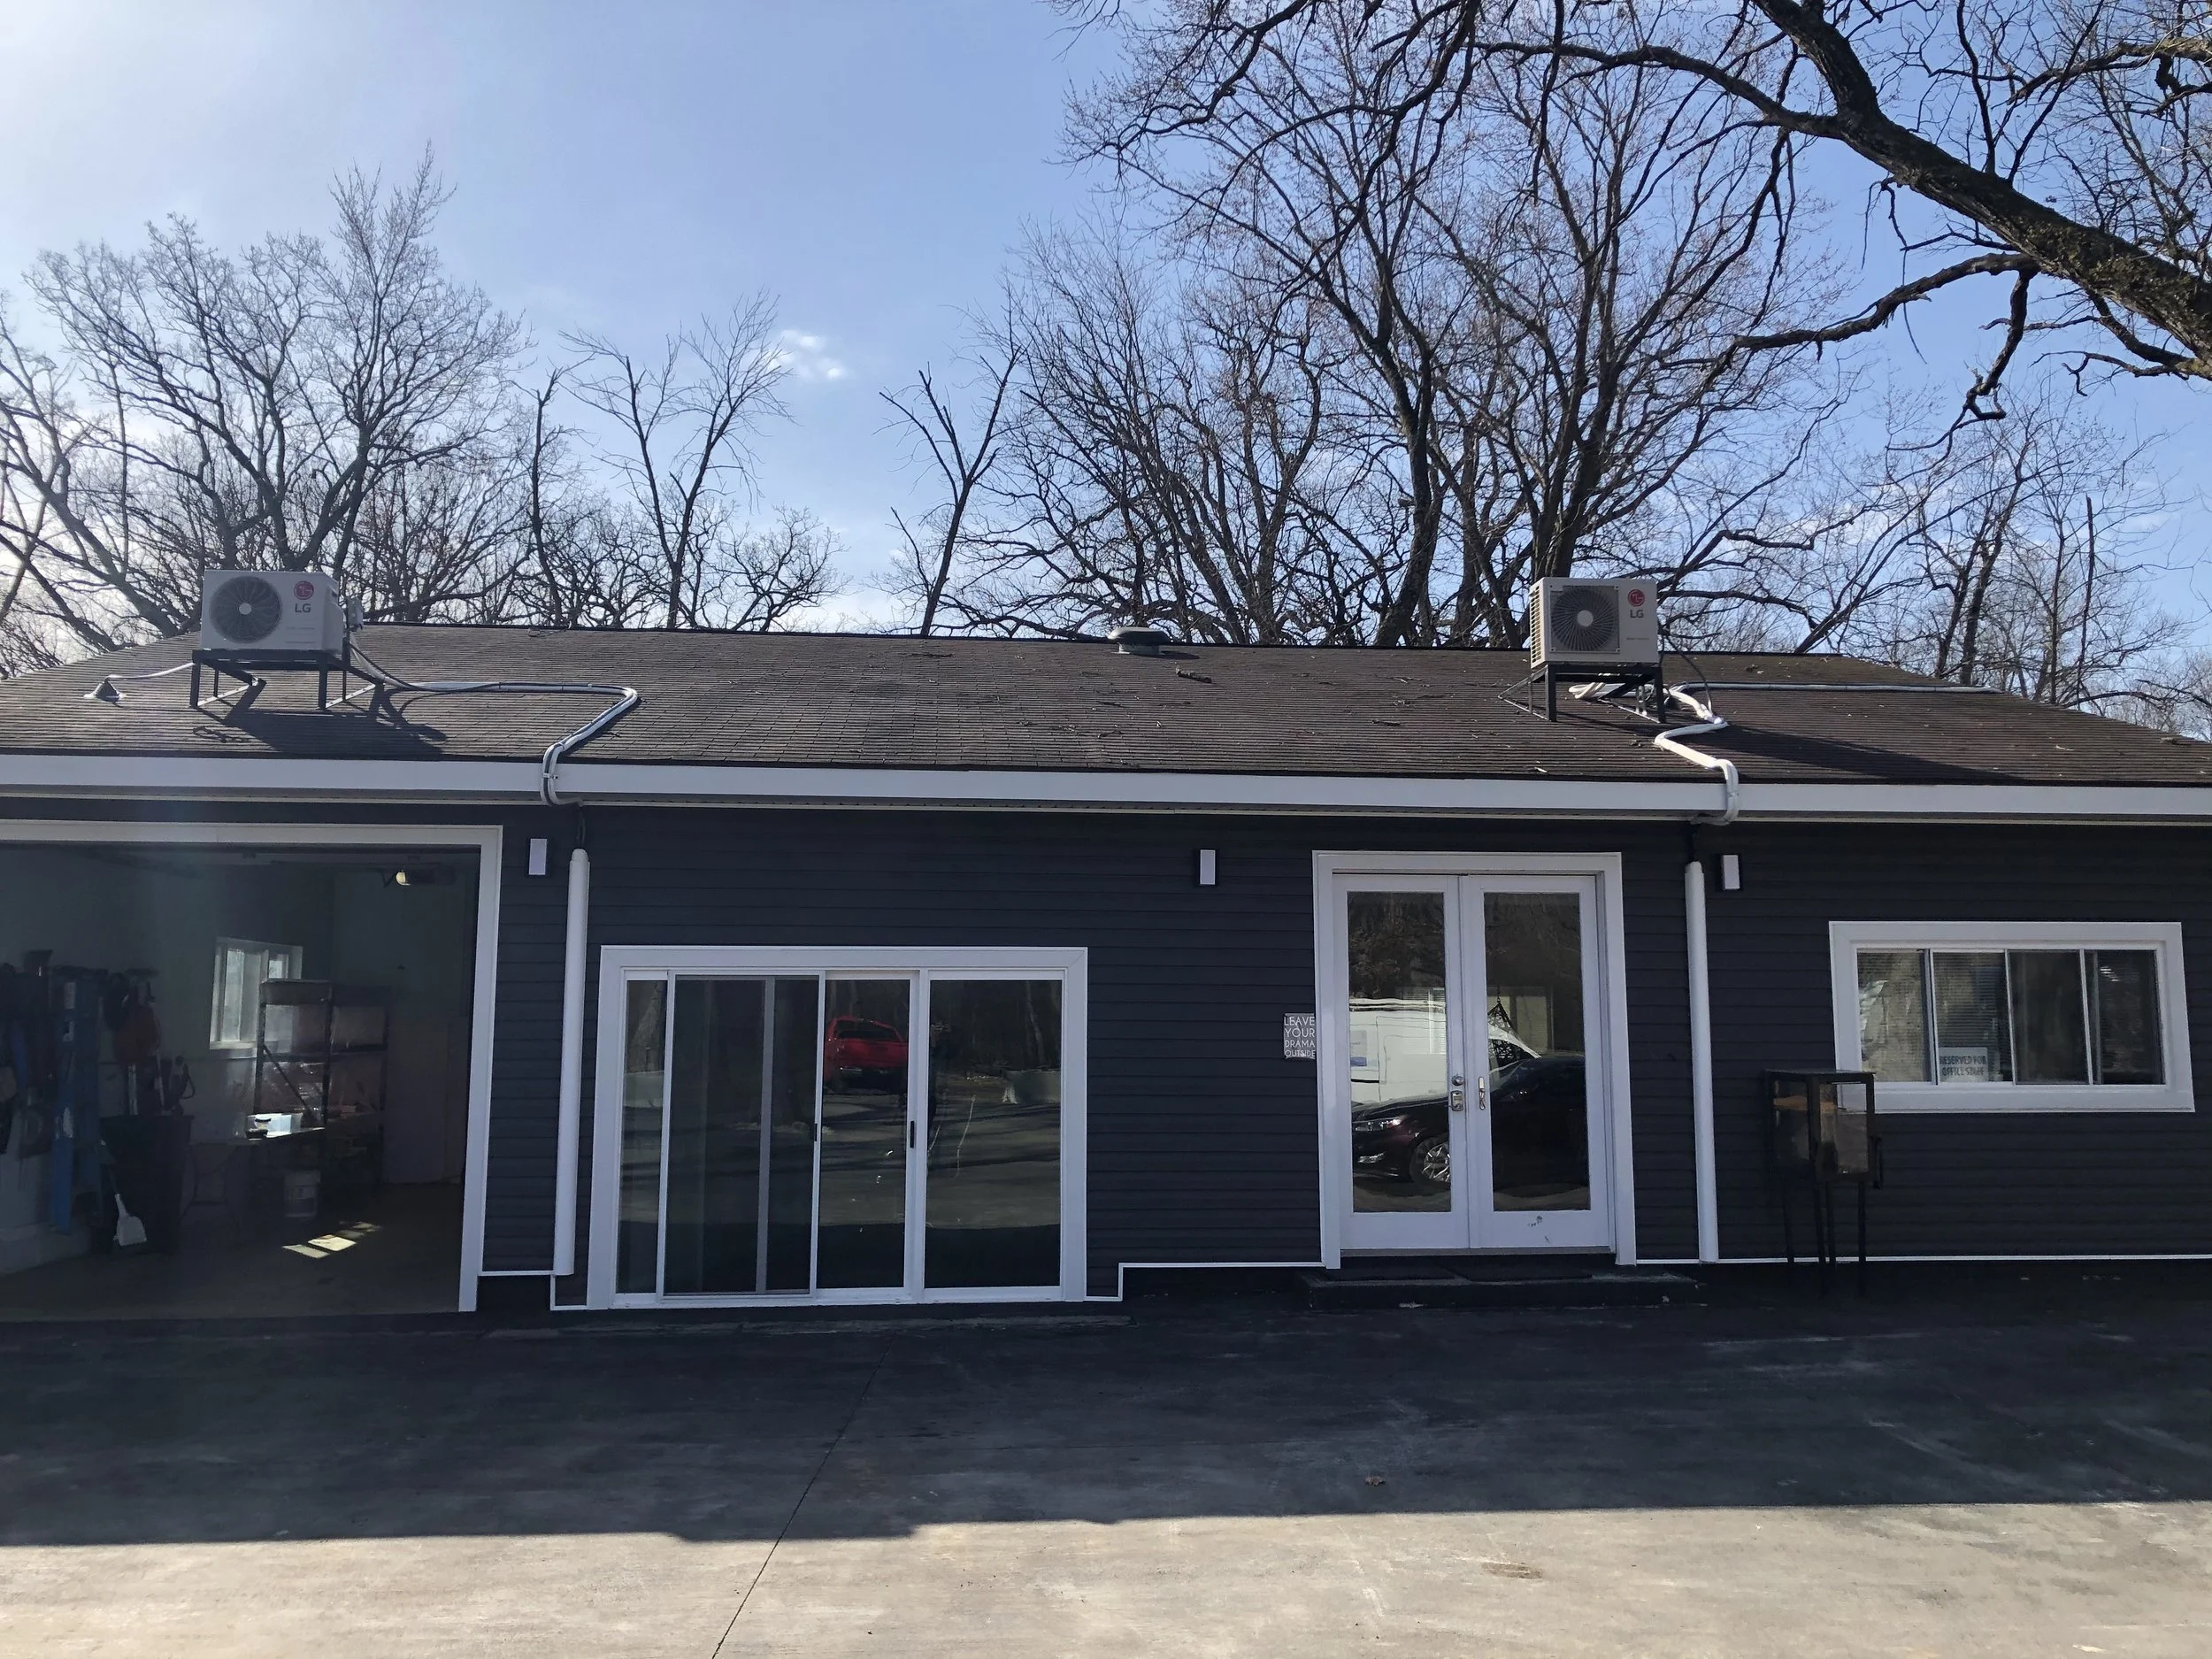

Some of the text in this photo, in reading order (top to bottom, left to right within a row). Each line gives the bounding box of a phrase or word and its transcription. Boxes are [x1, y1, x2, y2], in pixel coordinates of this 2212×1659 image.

[295, 603, 311, 612] LG
[1284, 1017, 1315, 1025] LEAVE
[1285, 1028, 1315, 1037] YOUR
